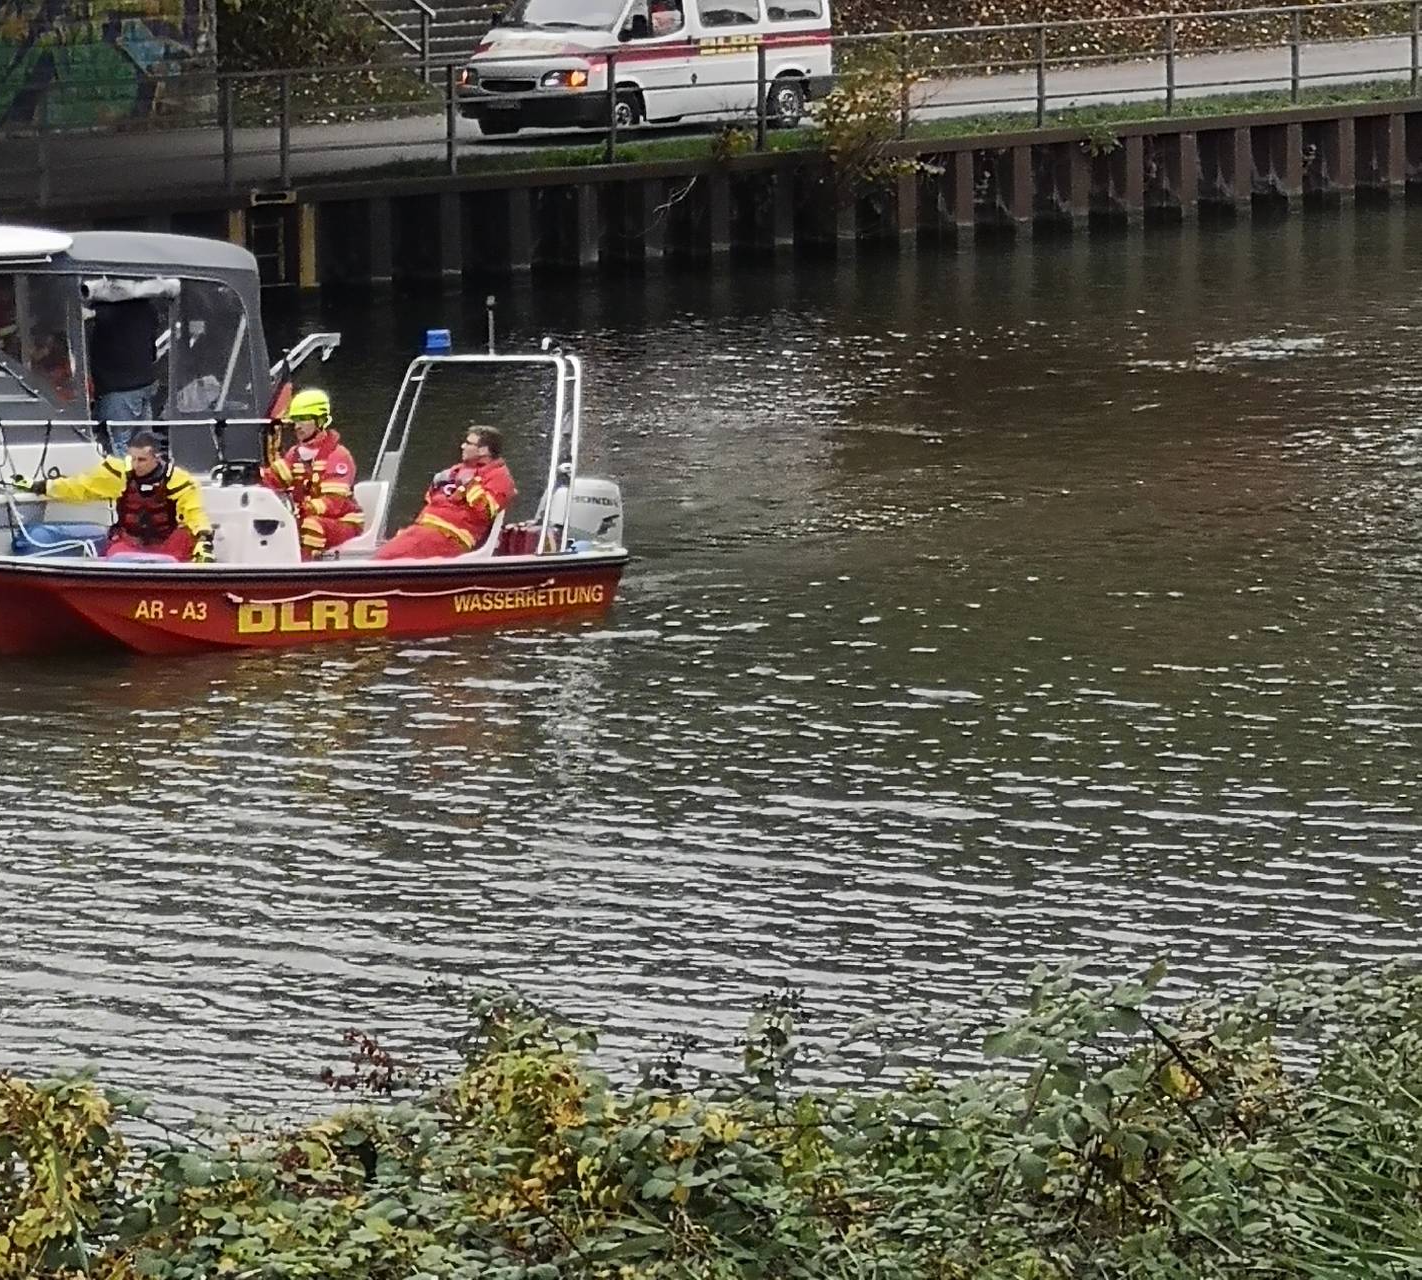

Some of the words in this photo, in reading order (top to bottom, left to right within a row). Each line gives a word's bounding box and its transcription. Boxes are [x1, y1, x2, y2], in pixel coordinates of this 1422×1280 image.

[135, 600, 164, 619] AR
[182, 601, 208, 621] A3
[454, 584, 604, 613] WASSERRETTUNG
[238, 599, 389, 633] DLRG
